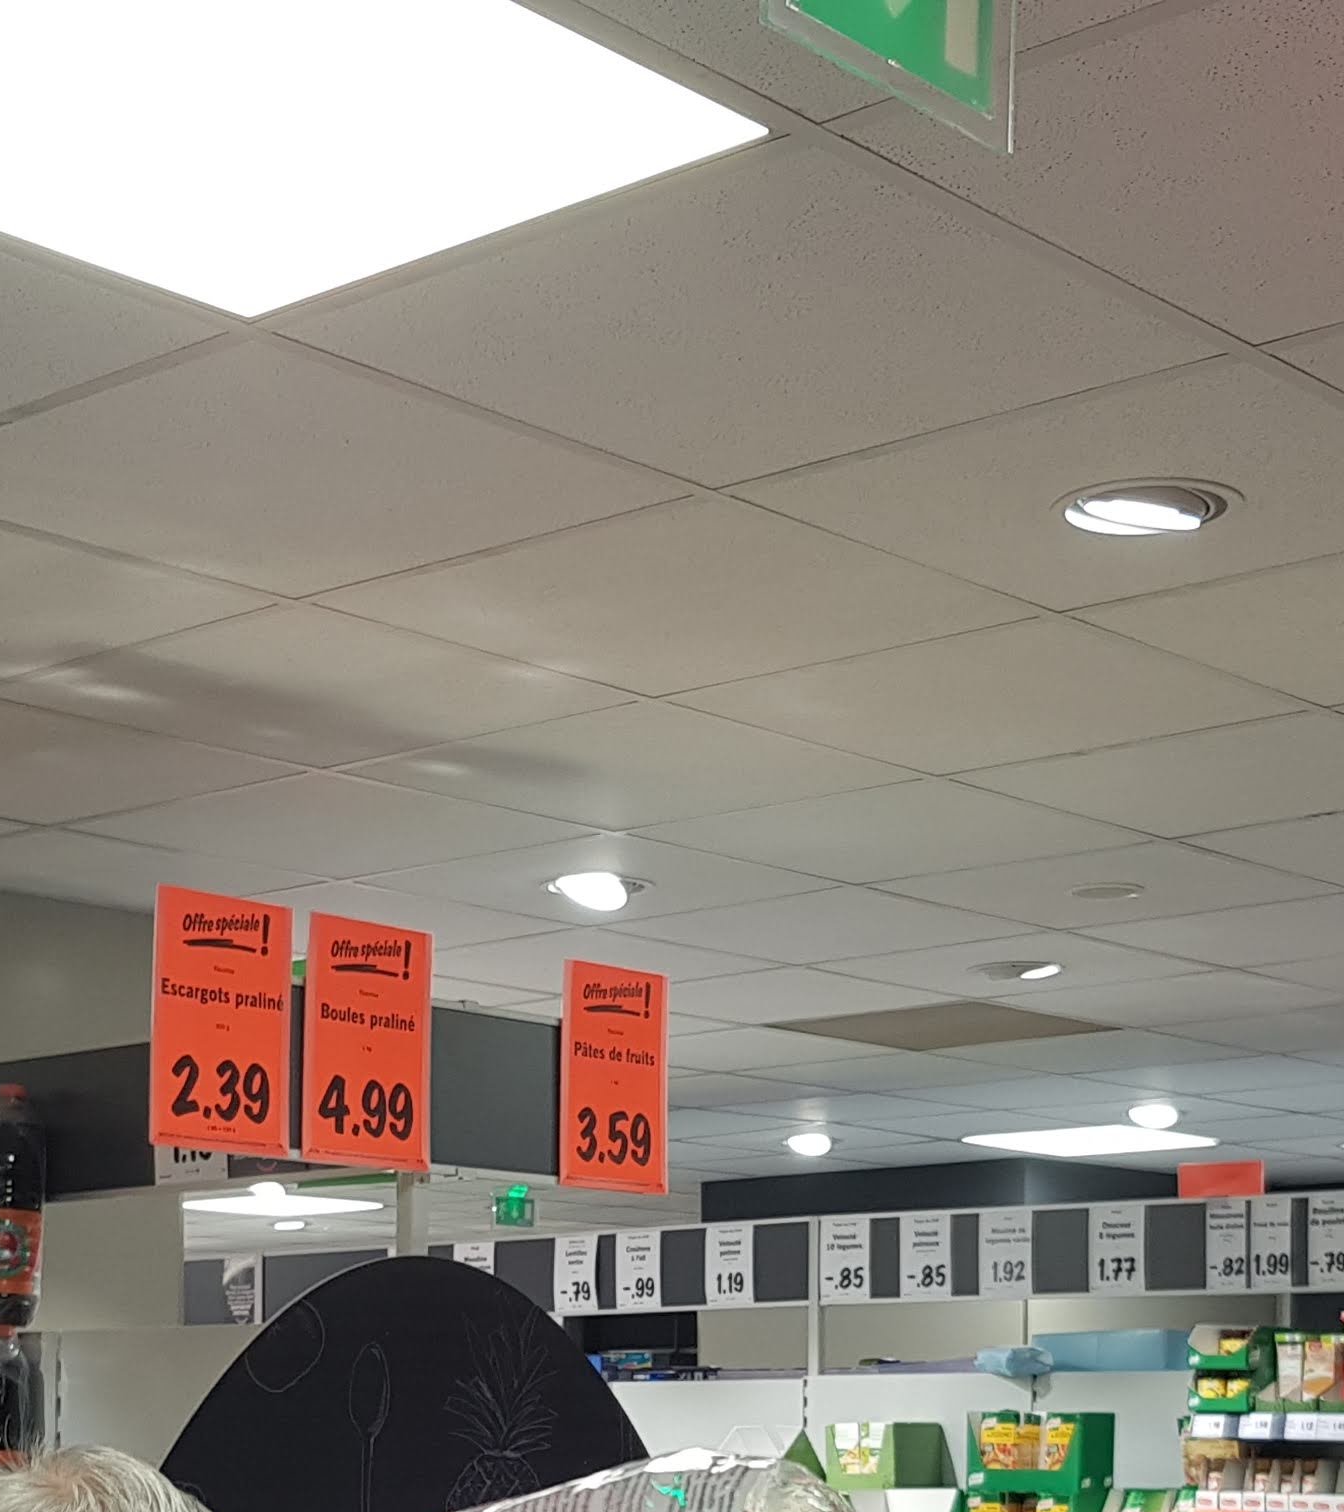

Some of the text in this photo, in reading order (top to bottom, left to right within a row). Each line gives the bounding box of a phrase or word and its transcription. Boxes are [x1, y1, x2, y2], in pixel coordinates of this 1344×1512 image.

[183, 913, 214, 932] Offre
[331, 940, 358, 957] Offre
[161, 978, 284, 1011] Escargots praliné
[583, 983, 607, 1000] Offre
[321, 1002, 415, 1032] Boules praliné
[574, 1041, 655, 1066] Pâtes de fruits
[171, 1054, 270, 1124] 2.39
[318, 1074, 414, 1141] 4.99
[576, 1106, 651, 1167] 3.59
[907, 1264, 946, 1287] -.85
[991, 1261, 1025, 1283] 1.92
[1098, 1257, 1136, 1281] 1.77
[1209, 1257, 1244, 1276] -.82
[1254, 1253, 1289, 1276] 1.99
[623, 1277, 655, 1299] -.99
[716, 1272, 744, 1294] 1.19
[825, 1267, 863, 1289] -.85
[560, 1281, 591, 1302] -.79
